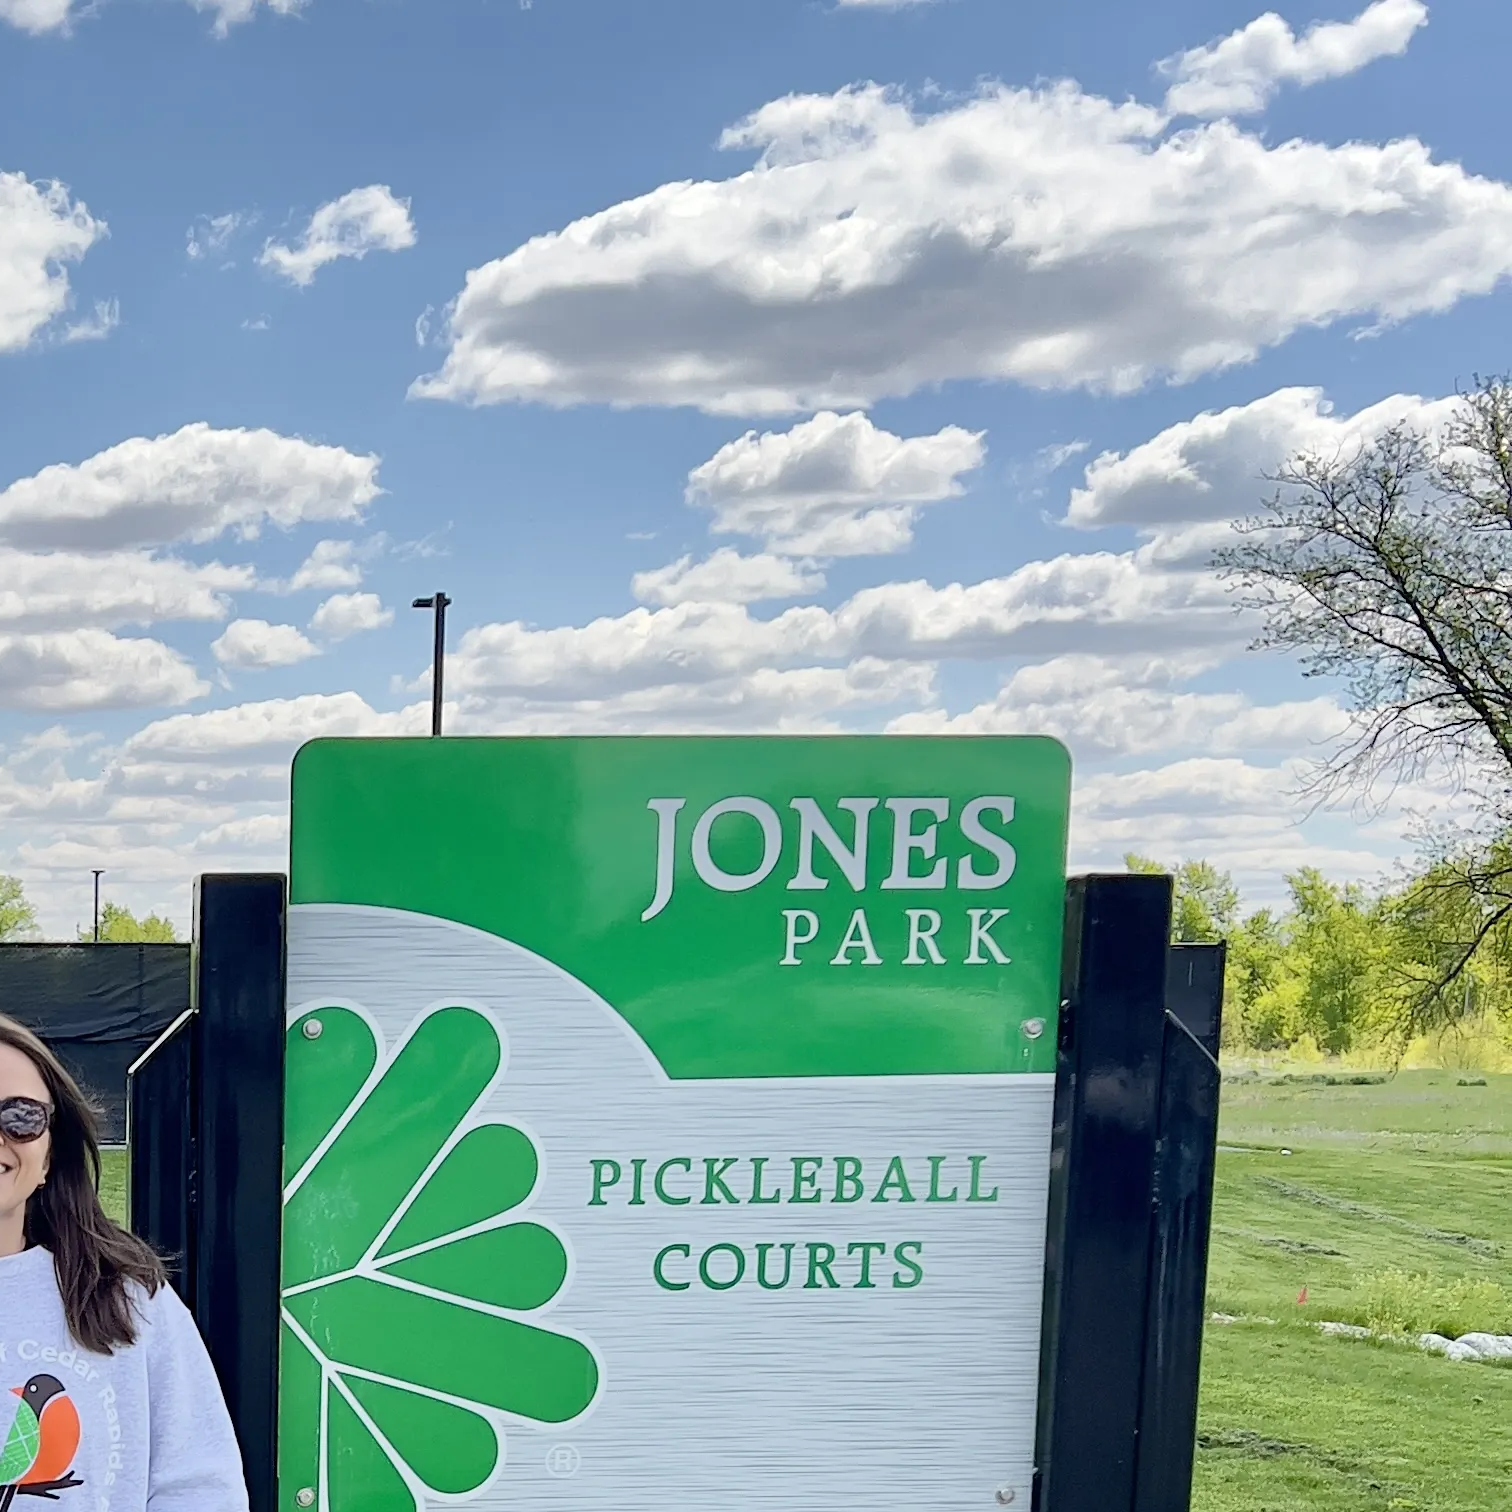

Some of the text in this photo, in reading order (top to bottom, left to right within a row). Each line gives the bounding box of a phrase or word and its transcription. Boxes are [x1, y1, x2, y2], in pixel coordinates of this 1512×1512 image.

[641, 795, 1016, 922] JONES
[779, 908, 1011, 966] PARK
[587, 1154, 999, 1207] PICKLEBALL
[652, 1241, 924, 1292] COURTS
[16, 1338, 100, 1383] Cedar
[97, 1381, 127, 1487] Rapids
